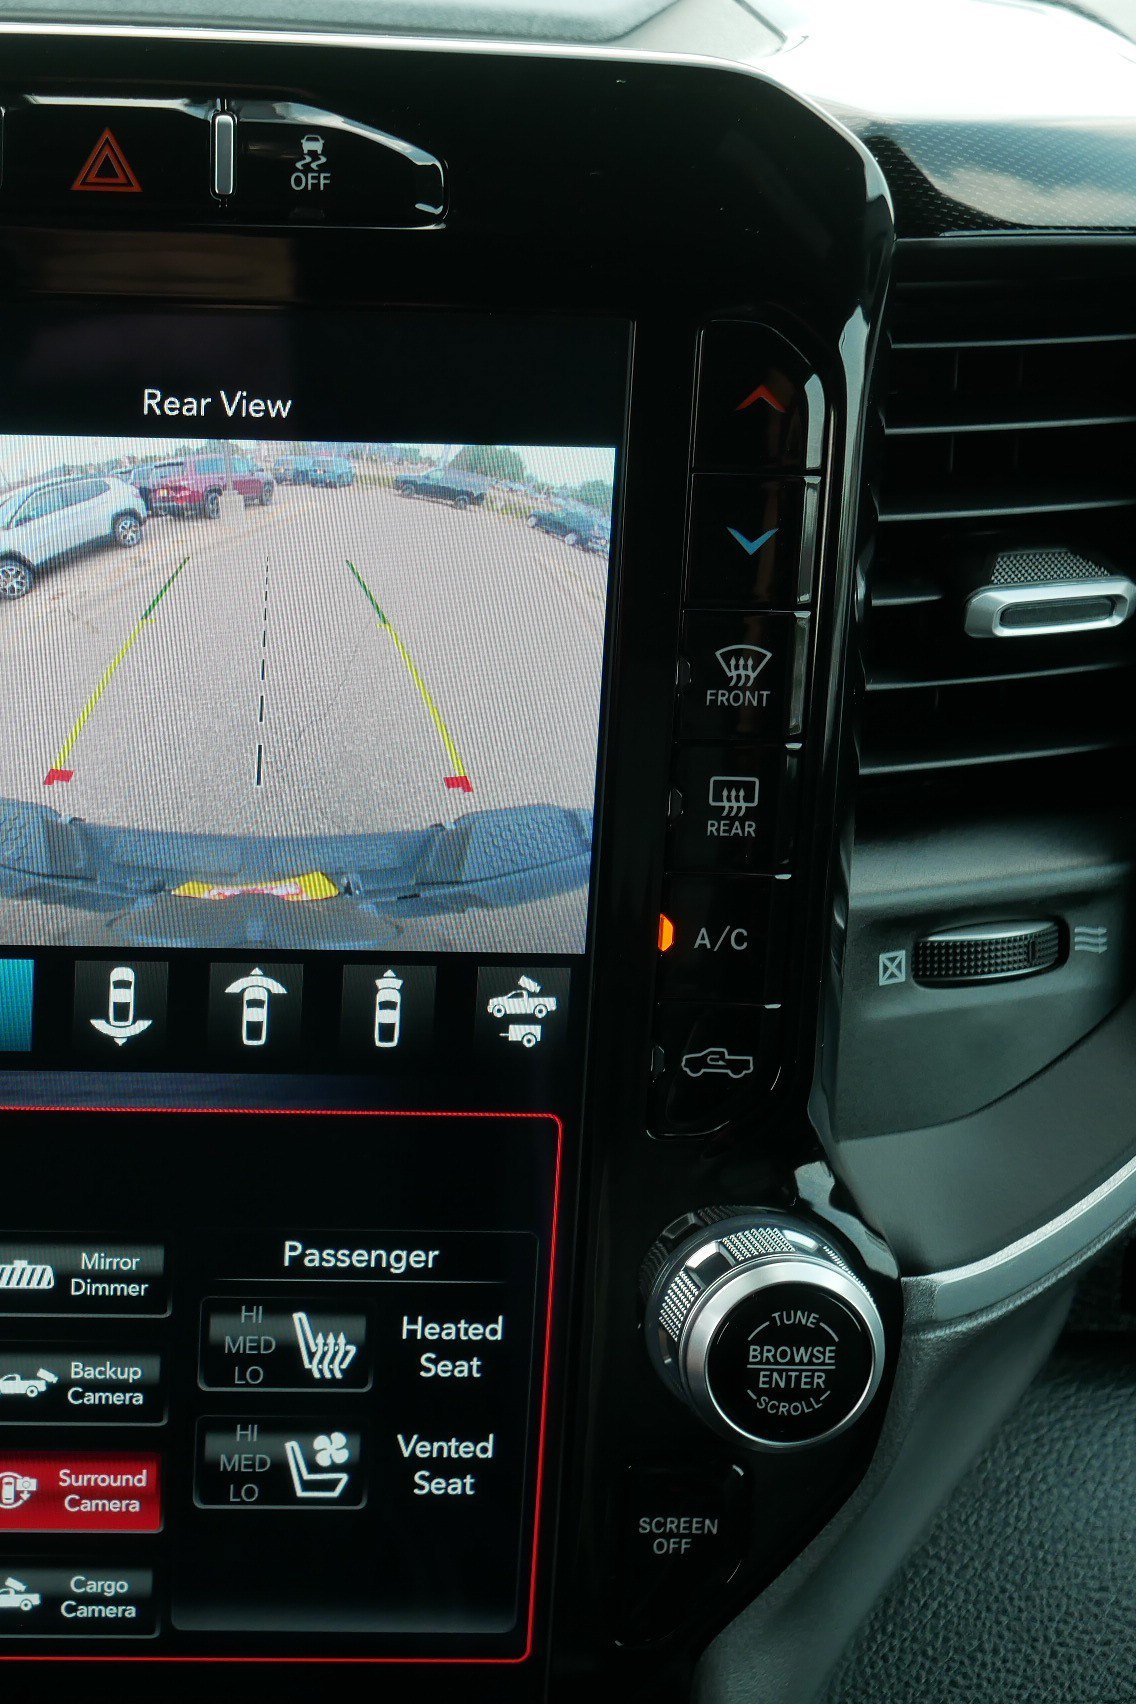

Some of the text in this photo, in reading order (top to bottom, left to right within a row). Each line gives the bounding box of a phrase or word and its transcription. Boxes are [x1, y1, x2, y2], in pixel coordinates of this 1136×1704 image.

[290, 172, 331, 191] OFF
[143, 388, 292, 419] Rear View
[706, 689, 771, 707] FRONT
[706, 819, 756, 838] REAR
[693, 925, 748, 952] A/C
[81, 1252, 141, 1271] Mirror
[283, 1240, 440, 1274] Passenger
[70, 1278, 149, 1297] Dimmer
[240, 1305, 263, 1324] HI
[771, 1308, 821, 1329] TUNE
[401, 1314, 504, 1341] Heated
[224, 1335, 276, 1354] MED
[748, 1345, 837, 1364] BROWSE
[70, 1360, 142, 1384] Backup
[234, 1365, 264, 1385] LO
[419, 1352, 482, 1378] Seat
[758, 1370, 826, 1389] ENTER
[67, 1386, 144, 1406] Camera
[756, 1396, 823, 1417] SCROLL
[236, 1423, 258, 1442] HI
[396, 1433, 494, 1459] Vented
[219, 1453, 271, 1473] MED
[58, 1468, 148, 1488] Surround
[413, 1470, 475, 1496] Seat
[229, 1483, 259, 1502] LO
[64, 1493, 140, 1513] Camera
[638, 1516, 718, 1535] SCREEN
[652, 1537, 692, 1555] OFF
[69, 1575, 129, 1597] Cargo
[60, 1600, 137, 1618] Camera
